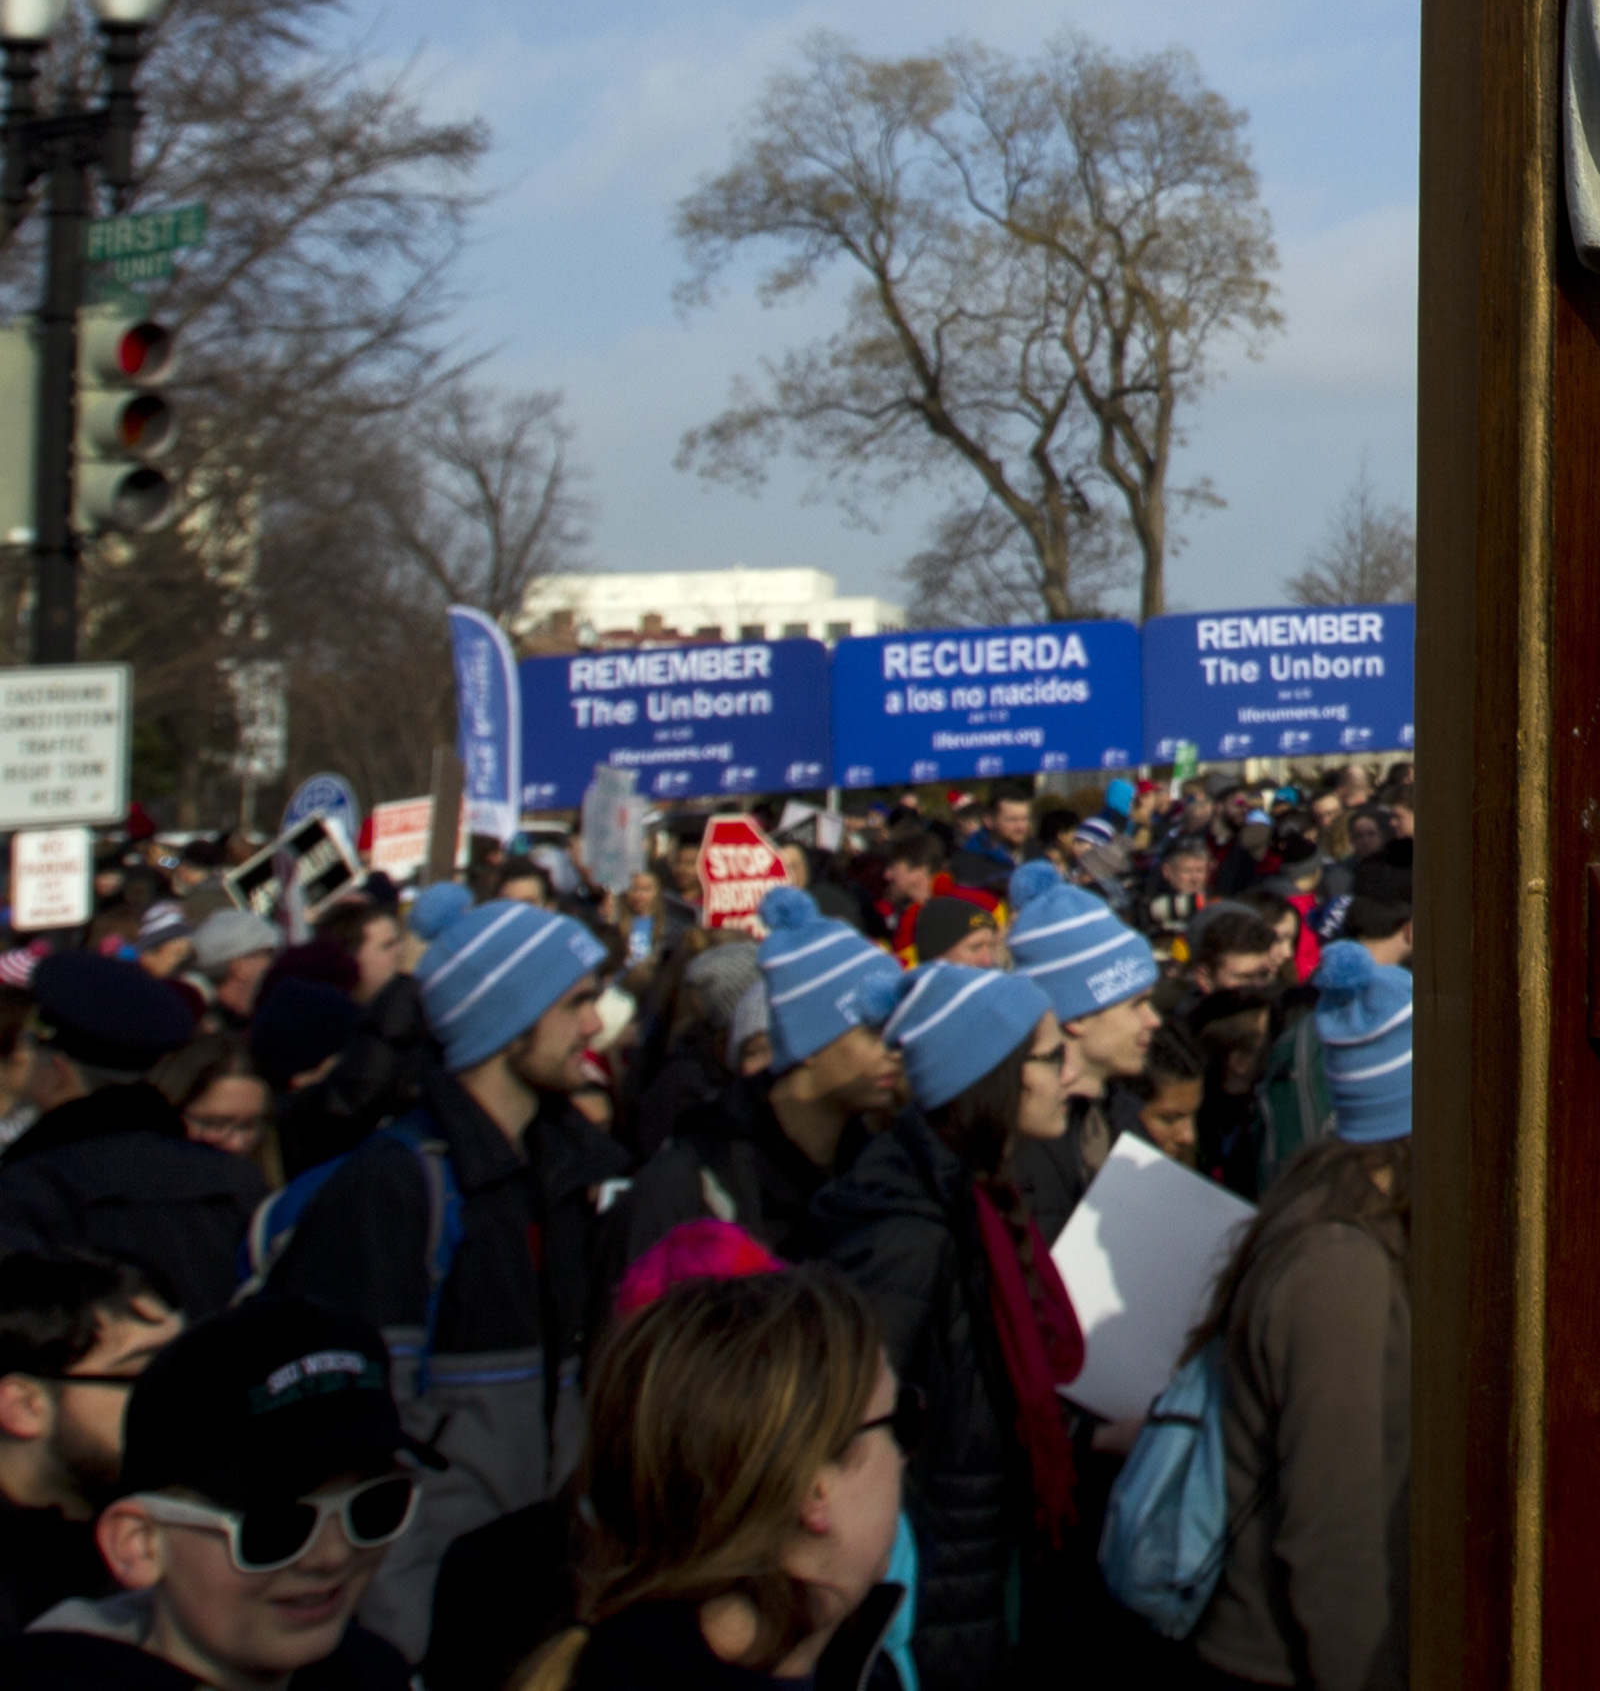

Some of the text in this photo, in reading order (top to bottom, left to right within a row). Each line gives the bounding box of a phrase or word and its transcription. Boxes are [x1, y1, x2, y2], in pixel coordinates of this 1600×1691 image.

[88, 212, 174, 259] FIRST
[1196, 613, 1384, 651] REMEMBER
[569, 646, 772, 692] REMEMBER
[882, 633, 1090, 680] RECUERDA
[1199, 651, 1385, 686] The Unborn
[571, 688, 772, 728] The Unborn
[884, 676, 1090, 715] a los no nacidos
[1237, 703, 1350, 725] liferunners.org
[609, 742, 734, 767] liferunners.org
[932, 726, 1045, 751] liferunners.org
[708, 843, 773, 878] STOP
[709, 876, 788, 914] ABORT
